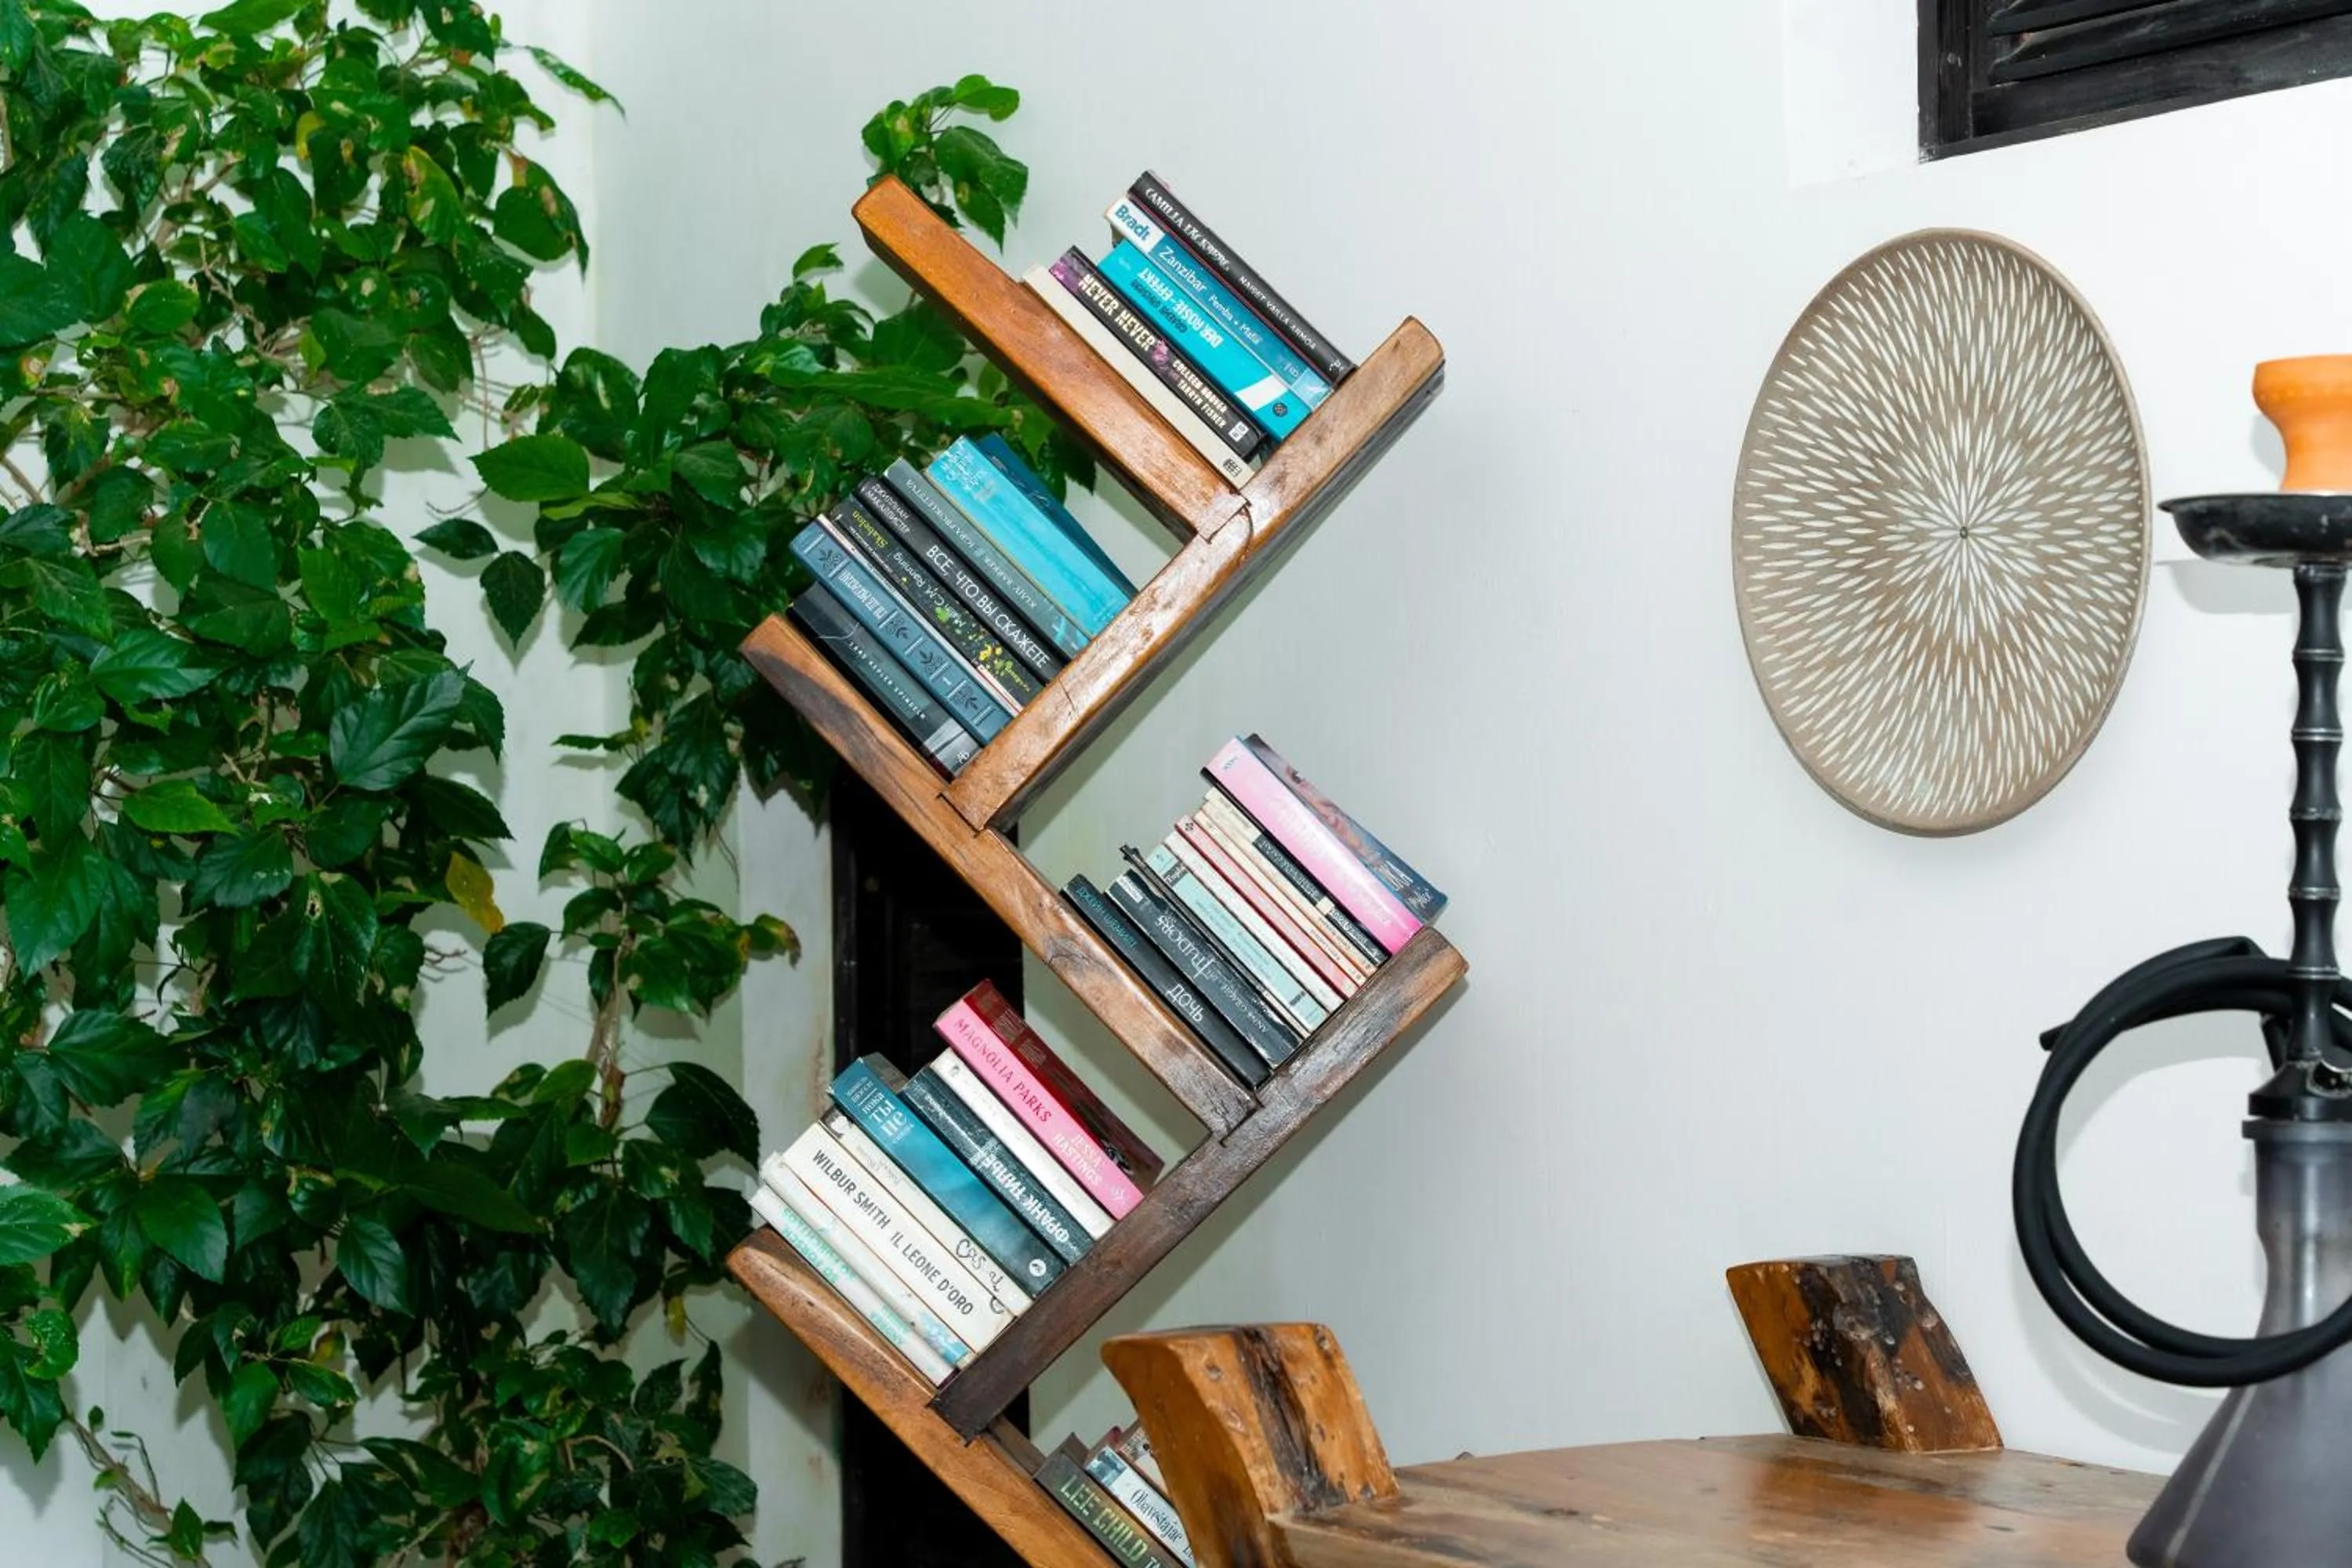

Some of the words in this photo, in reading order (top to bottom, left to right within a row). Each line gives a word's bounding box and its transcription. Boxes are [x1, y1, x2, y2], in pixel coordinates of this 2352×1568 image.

[1114, 205, 1151, 240] Bradt
[1145, 187, 1185, 226] CAMILLA
[1158, 246, 1207, 293] Zanzibar
[1207, 294, 1235, 320] Pemba
[1078, 273, 1120, 315] NEVER
[1115, 310, 1156, 351] NEVER
[1199, 325, 1224, 349] DER
[1172, 359, 1202, 388] COLLEEN
[1176, 379, 1203, 405] TARRYN
[1200, 403, 1226, 428] FISHER
[924, 545, 954, 575] ВСЕ,
[951, 570, 980, 599] ЧТО
[975, 594, 998, 616] ВЫ
[994, 612, 1049, 667] СКАЖЕТЕ
[953, 1018, 1014, 1083] MAGNOLIA
[1013, 1082, 1051, 1122] PARKS
[1052, 1133, 1102, 1186] HASTINGS
[1072, 1134, 1102, 1167] JESSA
[811, 1150, 857, 1194] WILBUR
[852, 1192, 891, 1229] SMITH
[889, 1232, 905, 1248] IL
[902, 1244, 940, 1281] LEONE
[936, 1279, 975, 1315] D'ORO
[1022, 1196, 1072, 1243] ФРАНК
[1060, 1475, 1100, 1515] LEE
[1093, 1507, 1149, 1561] CHILD
